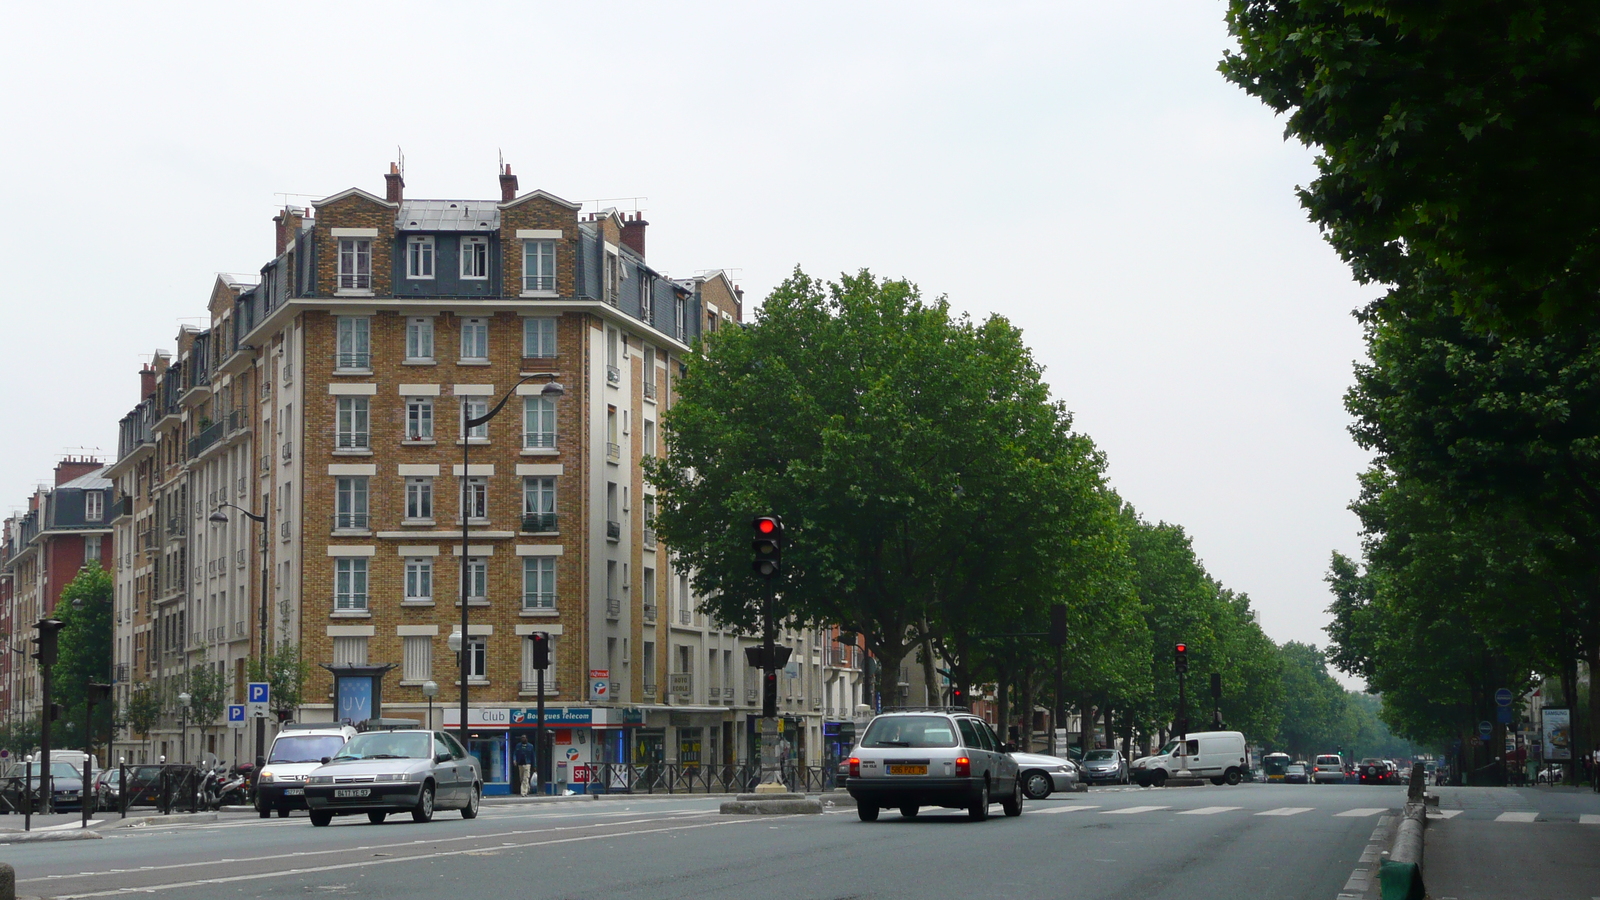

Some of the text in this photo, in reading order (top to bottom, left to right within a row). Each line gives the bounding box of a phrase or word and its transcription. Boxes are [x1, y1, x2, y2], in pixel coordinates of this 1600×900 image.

[253, 687, 264, 700] P
[342, 697, 366, 711] UV
[232, 707, 241, 719] P
[482, 711, 505, 721] Club
[527, 712, 561, 721] Bougues
[917, 765, 925, 774] 75
